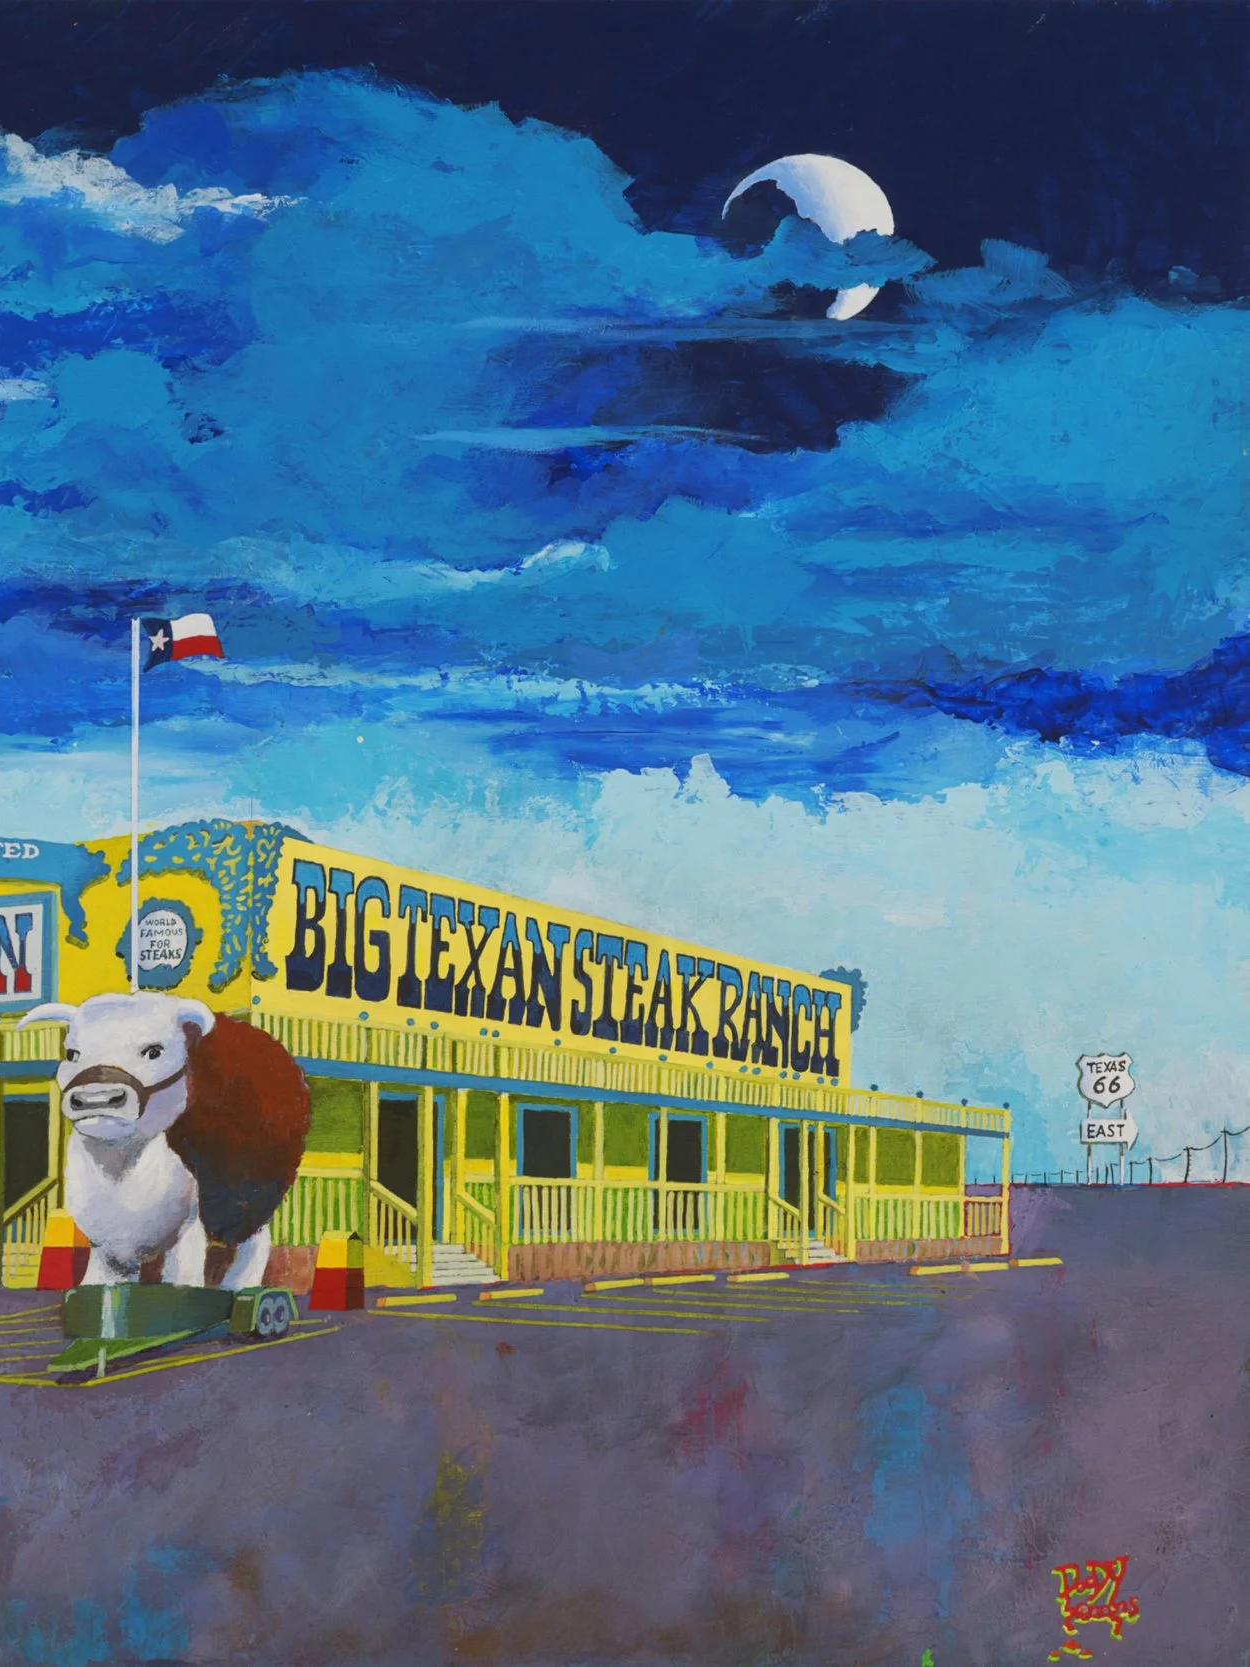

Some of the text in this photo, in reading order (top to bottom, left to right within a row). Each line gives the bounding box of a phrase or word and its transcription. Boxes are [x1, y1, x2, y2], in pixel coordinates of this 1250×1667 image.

[145, 918, 177, 926] WORLD
[140, 928, 183, 938] FAMOUS
[150, 939, 170, 949] FOR
[140, 948, 182, 961] STEAKS
[285, 858, 842, 1077] BIG TEXAN STEAK RANCH
[1086, 1060, 1127, 1074] TEXAS
[1093, 1075, 1121, 1094] 66
[1086, 1123, 1125, 1139] EAST
